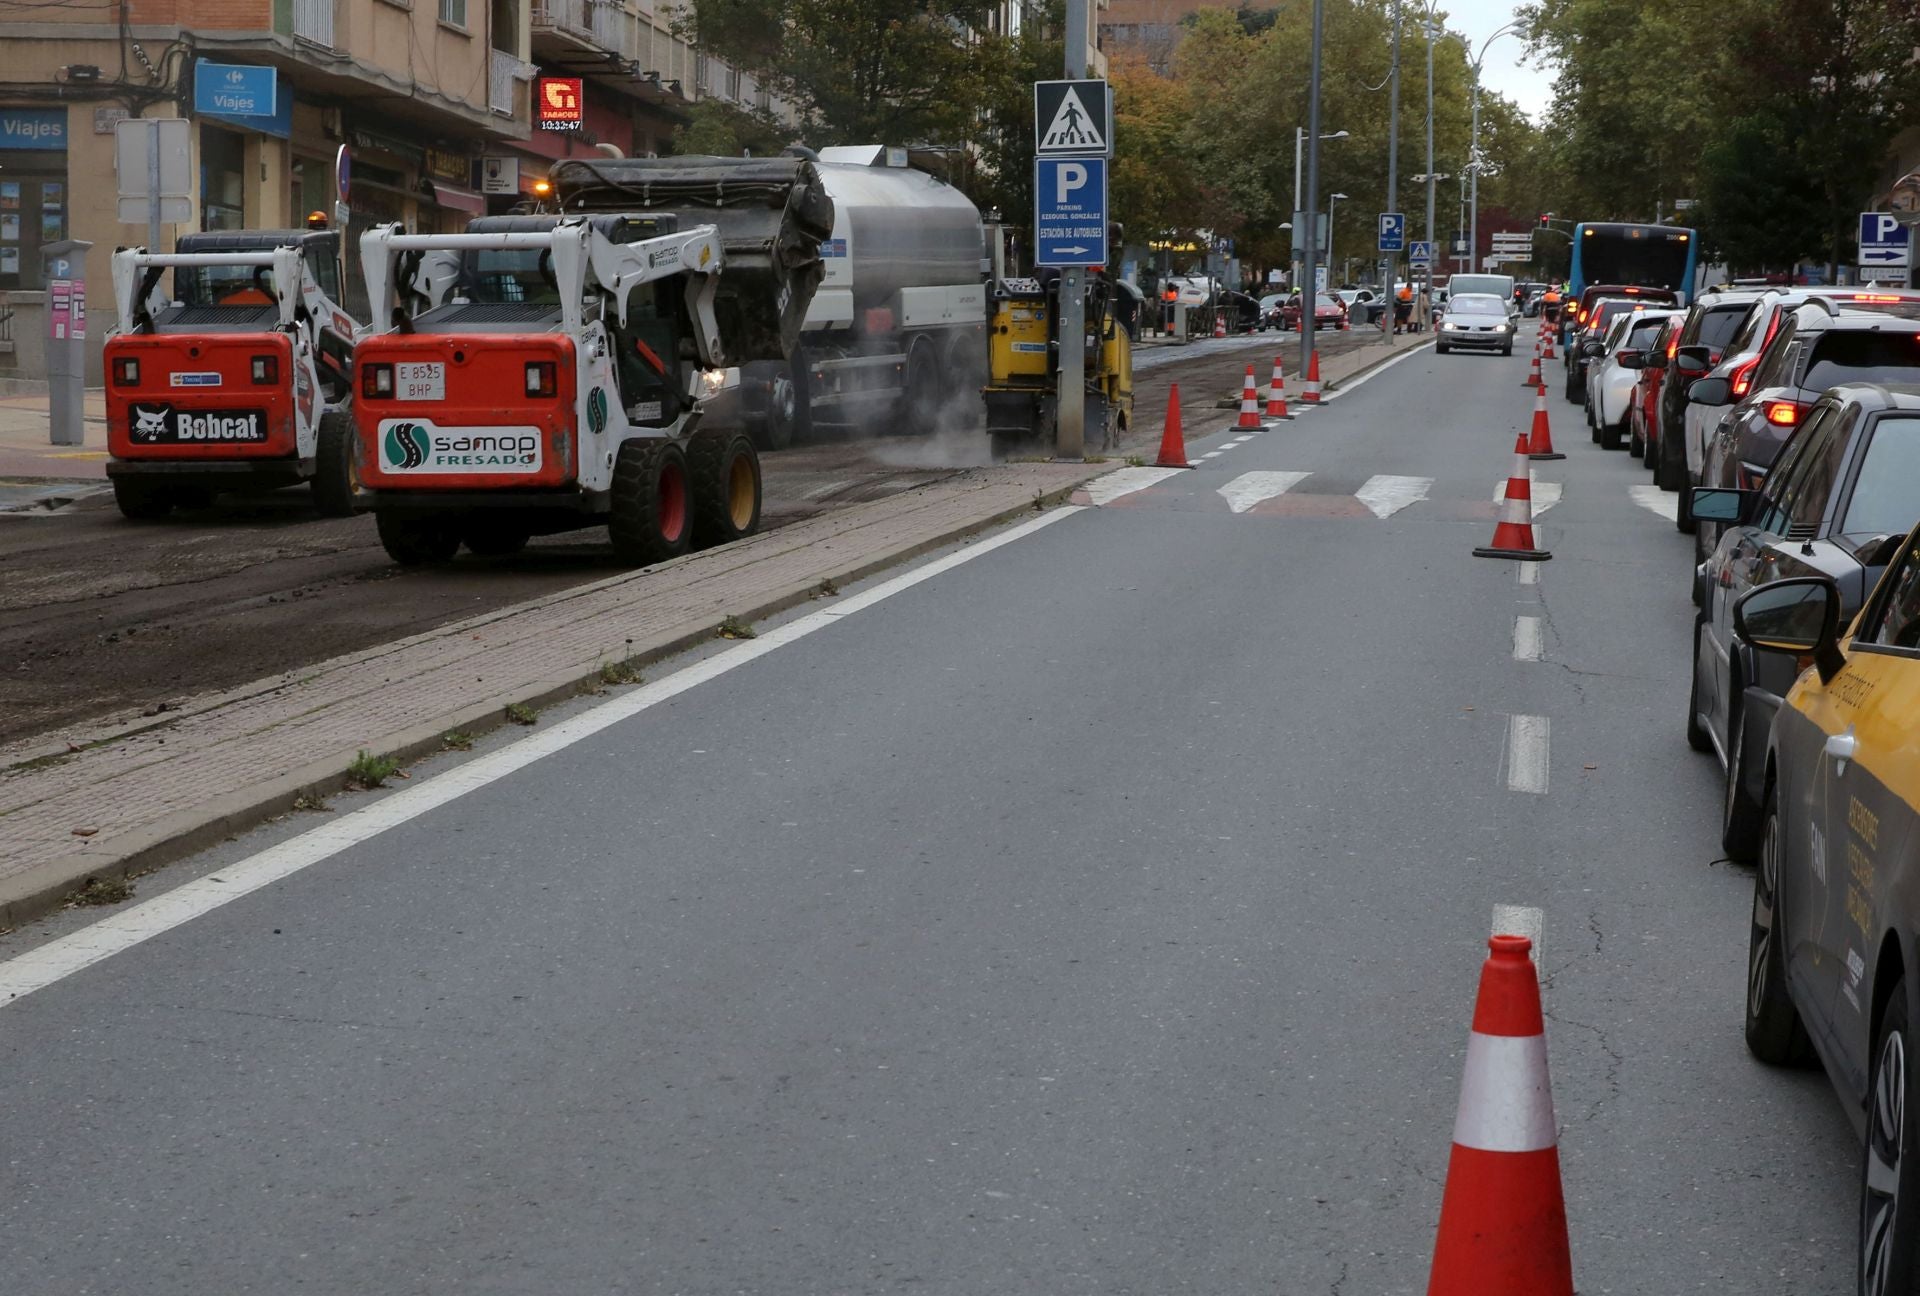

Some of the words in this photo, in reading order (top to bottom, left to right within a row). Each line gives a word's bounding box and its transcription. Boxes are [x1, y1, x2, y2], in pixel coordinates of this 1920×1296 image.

[214, 95, 255, 111] Viajes
[543, 111, 579, 119] TABACOS
[3, 119, 62, 140] Viajes
[541, 120, 581, 130] 10:32:47
[1056, 163, 1088, 203] P
[1381, 216, 1396, 235] P
[1877, 215, 1899, 242] P
[57, 260, 70, 277] P
[400, 366, 407, 380] E
[412, 365, 441, 379] 8525
[408, 384, 432, 396] BHP
[177, 413, 258, 440] Bobcat
[435, 436, 536, 454] samop
[436, 454, 536, 465] FRESADO
